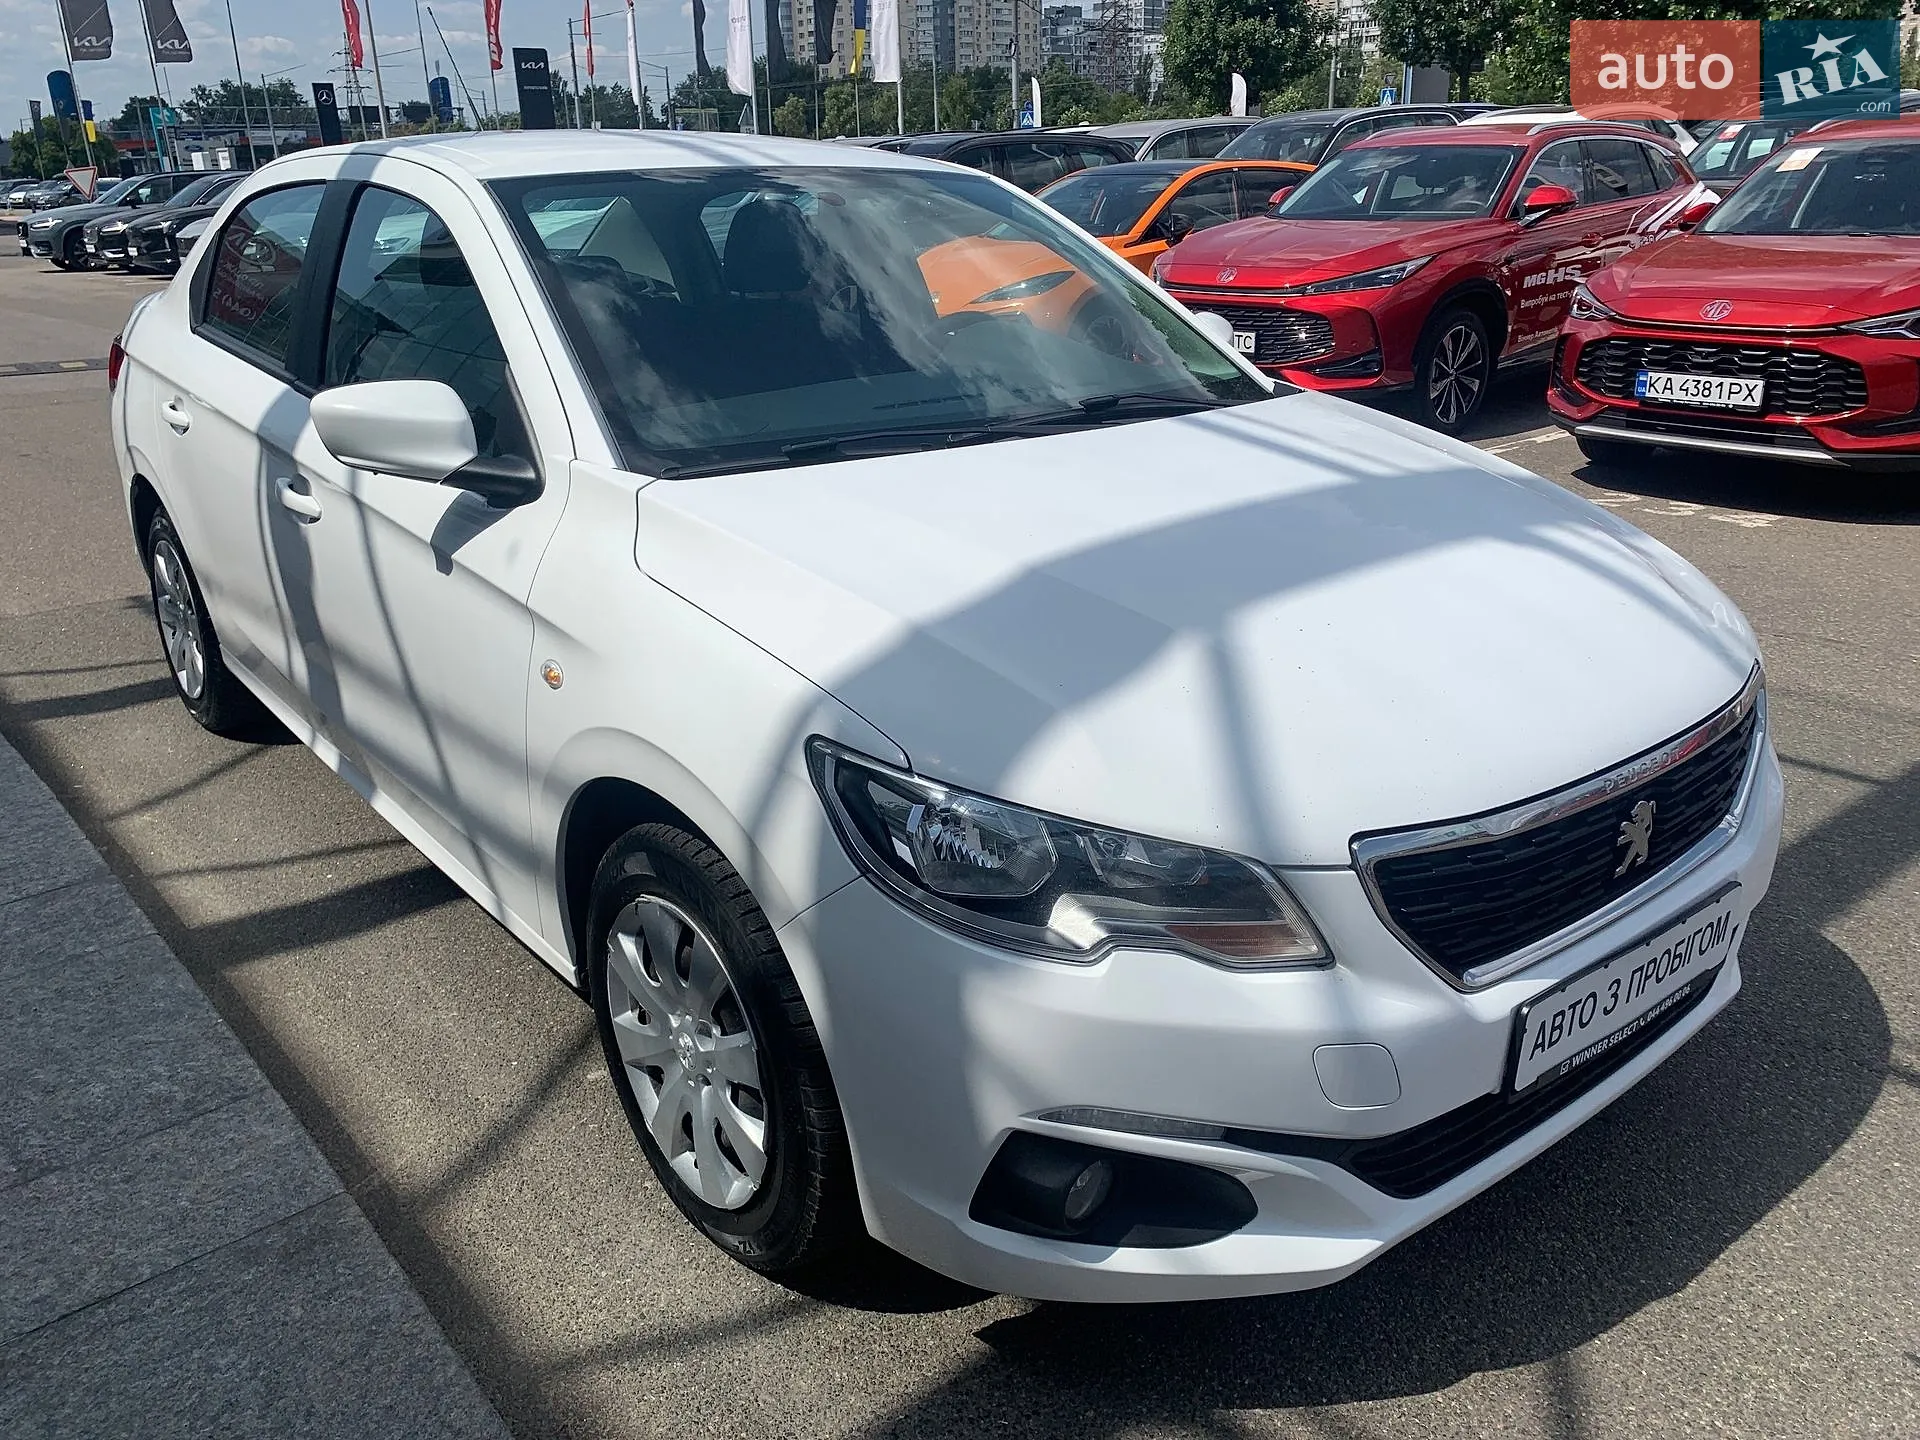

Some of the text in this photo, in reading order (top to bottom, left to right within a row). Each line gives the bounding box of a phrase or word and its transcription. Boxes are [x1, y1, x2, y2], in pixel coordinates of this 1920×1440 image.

[1235, 335, 1252, 349] TC
[1603, 747, 1681, 793] PEUGEOT
[1528, 991, 1598, 1061] АВТО
[1625, 910, 1731, 1004] ПРОБІГОМ
[1570, 1039, 1609, 1068] WINNER
[1608, 1021, 1640, 1047] SELECT
